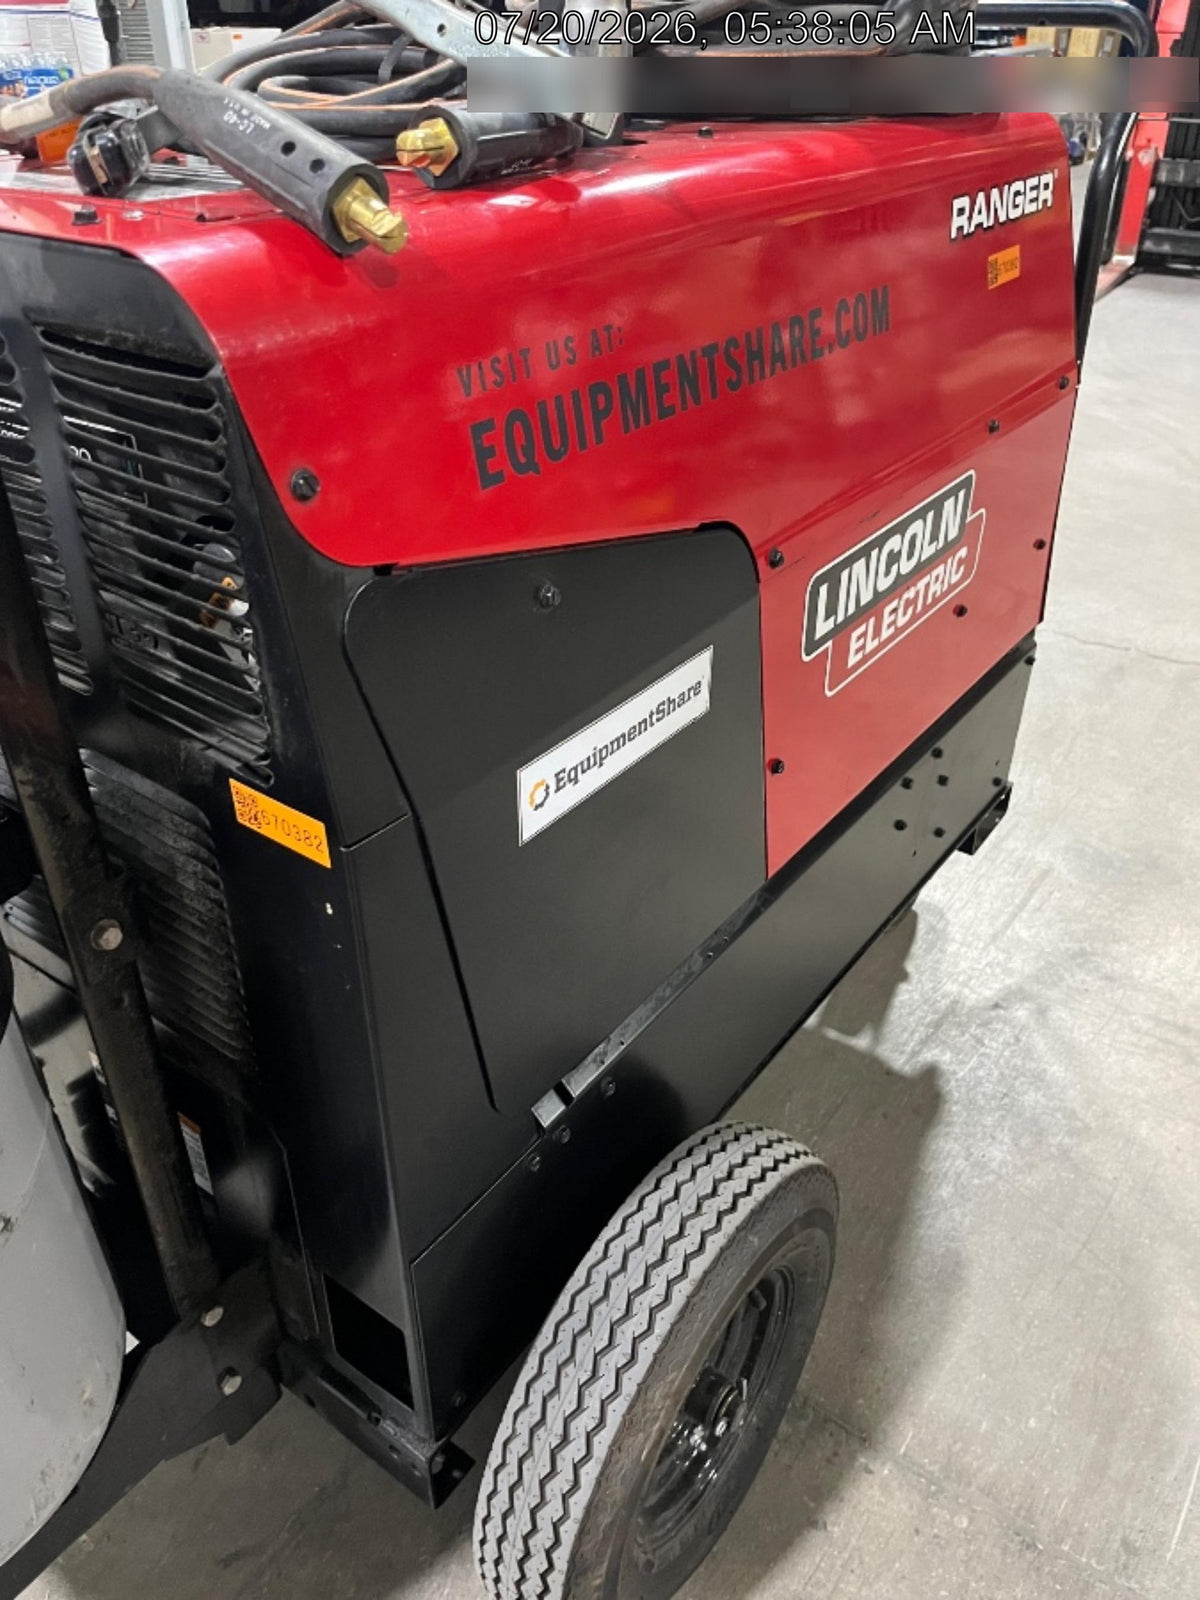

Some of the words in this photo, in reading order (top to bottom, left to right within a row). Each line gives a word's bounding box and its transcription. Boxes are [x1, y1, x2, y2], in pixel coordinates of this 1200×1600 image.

[950, 172, 1054, 240] RANGER
[457, 347, 531, 398] VISIT
[545, 333, 578, 371] US
[589, 323, 624, 359] AT:
[469, 285, 891, 491] EQUIPMENTSHARE.COM
[815, 488, 966, 641] LINCOLN
[847, 546, 968, 668] ELECTRIC
[554, 678, 702, 794] EquipmentShare
[261, 809, 324, 854] 670382
